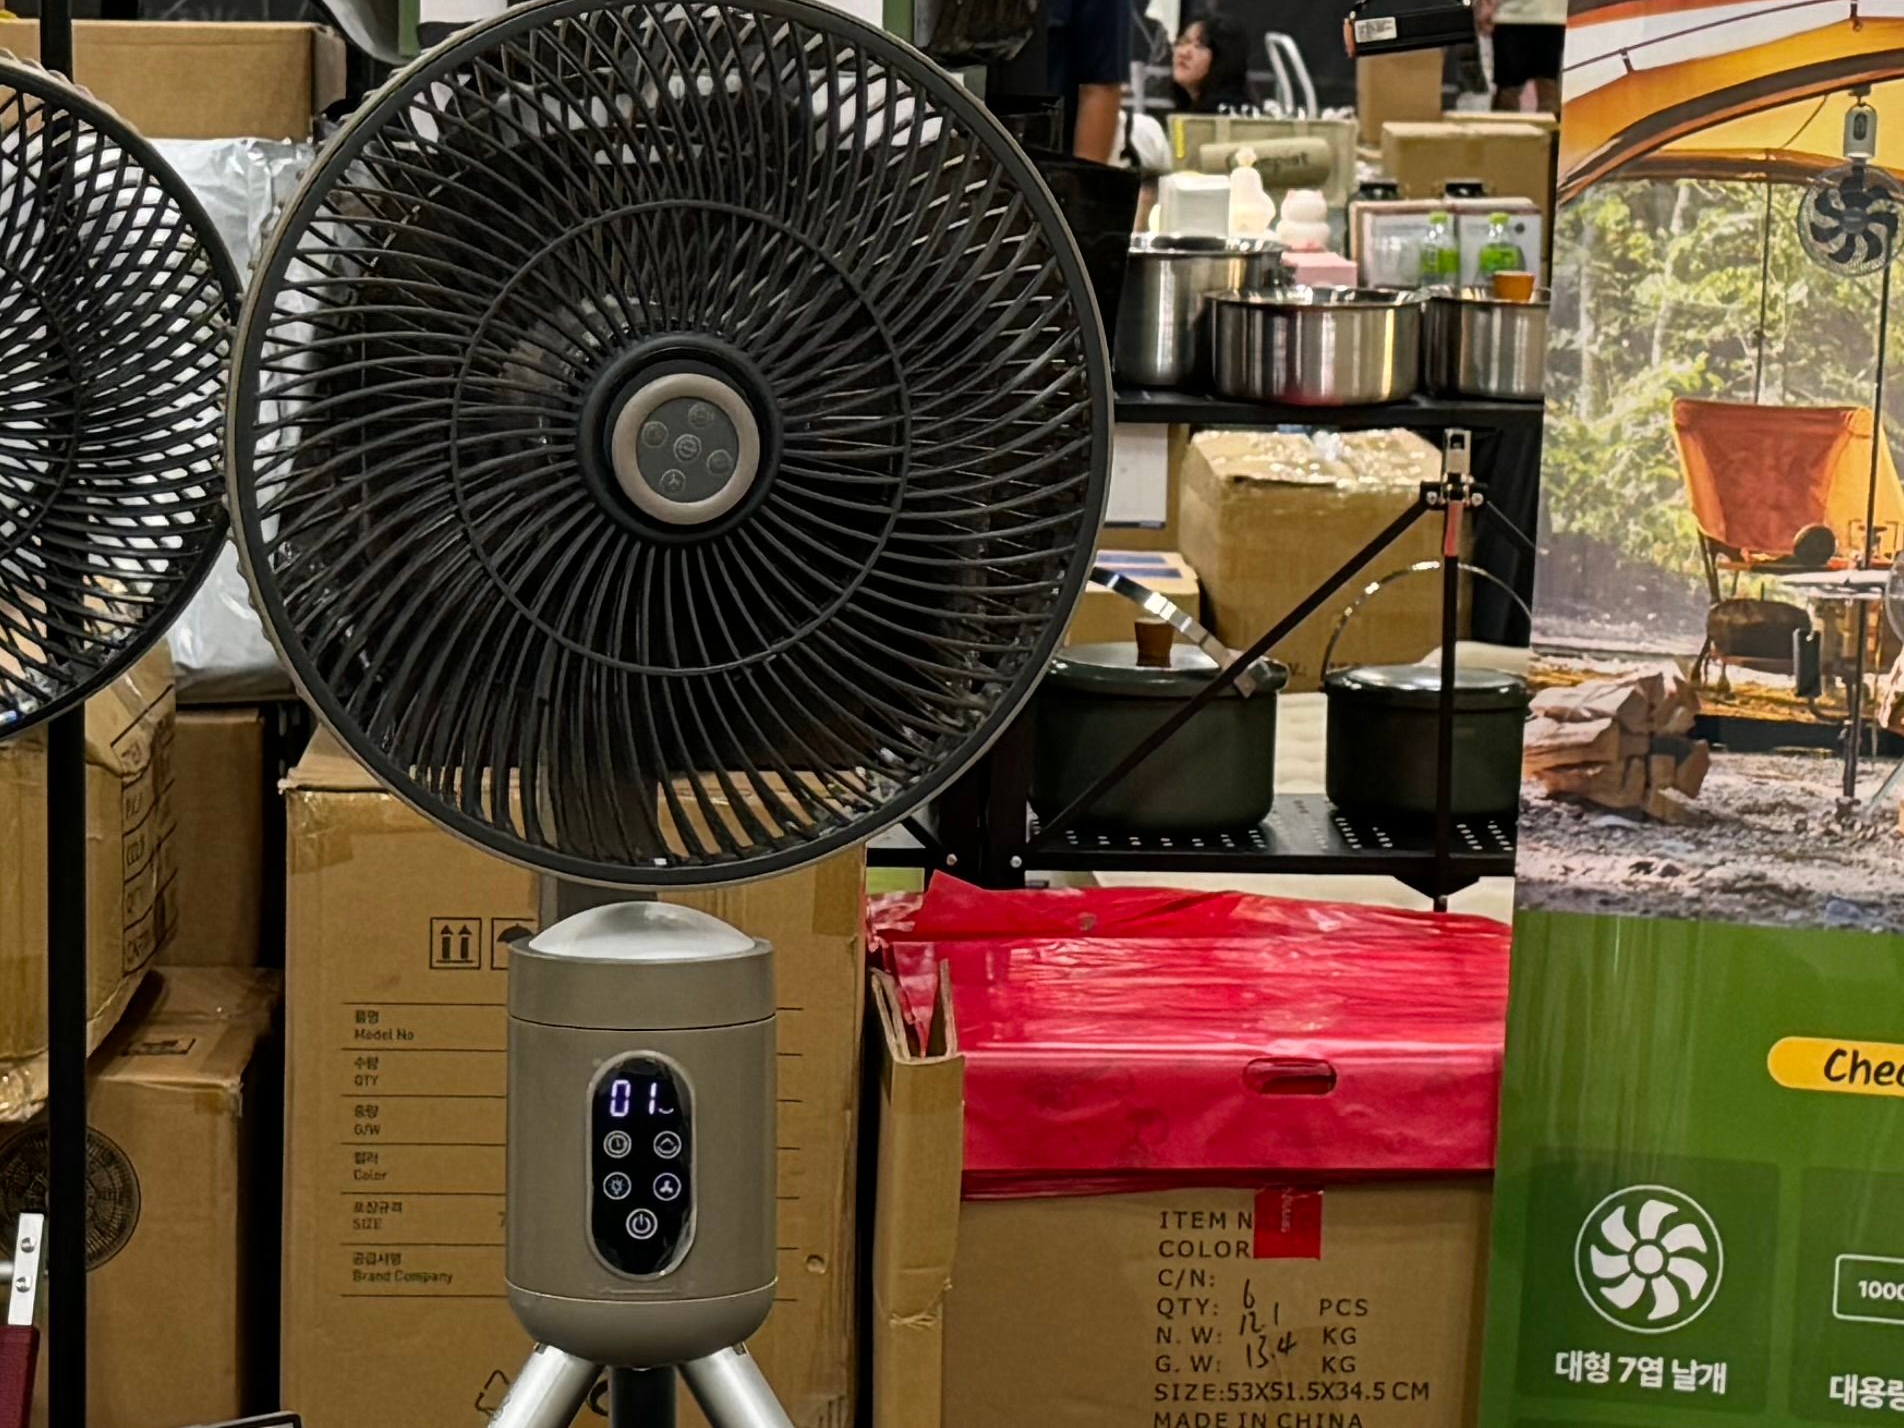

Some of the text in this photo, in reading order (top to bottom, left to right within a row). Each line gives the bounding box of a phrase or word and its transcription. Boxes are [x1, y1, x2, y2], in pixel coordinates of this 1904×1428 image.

[354, 1028, 414, 1041] Model No
[609, 1078, 658, 1118] 01
[353, 1169, 387, 1181] Color
[353, 1218, 383, 1230] SIZE
[1159, 1211, 1227, 1229] ITEM
[1158, 1240, 1251, 1259] COLOR
[353, 1270, 453, 1285] Brand Company
[1158, 1268, 1215, 1288] C/N:
[1157, 1297, 1369, 1320] QTY: PCS
[1322, 1327, 1357, 1345] KG
[1321, 1356, 1356, 1374] KG
[1555, 1349, 1728, 1395] 대형 7엽 날개
[1154, 1382, 1430, 1402] SIZE:53X51.5X34.5 CM
